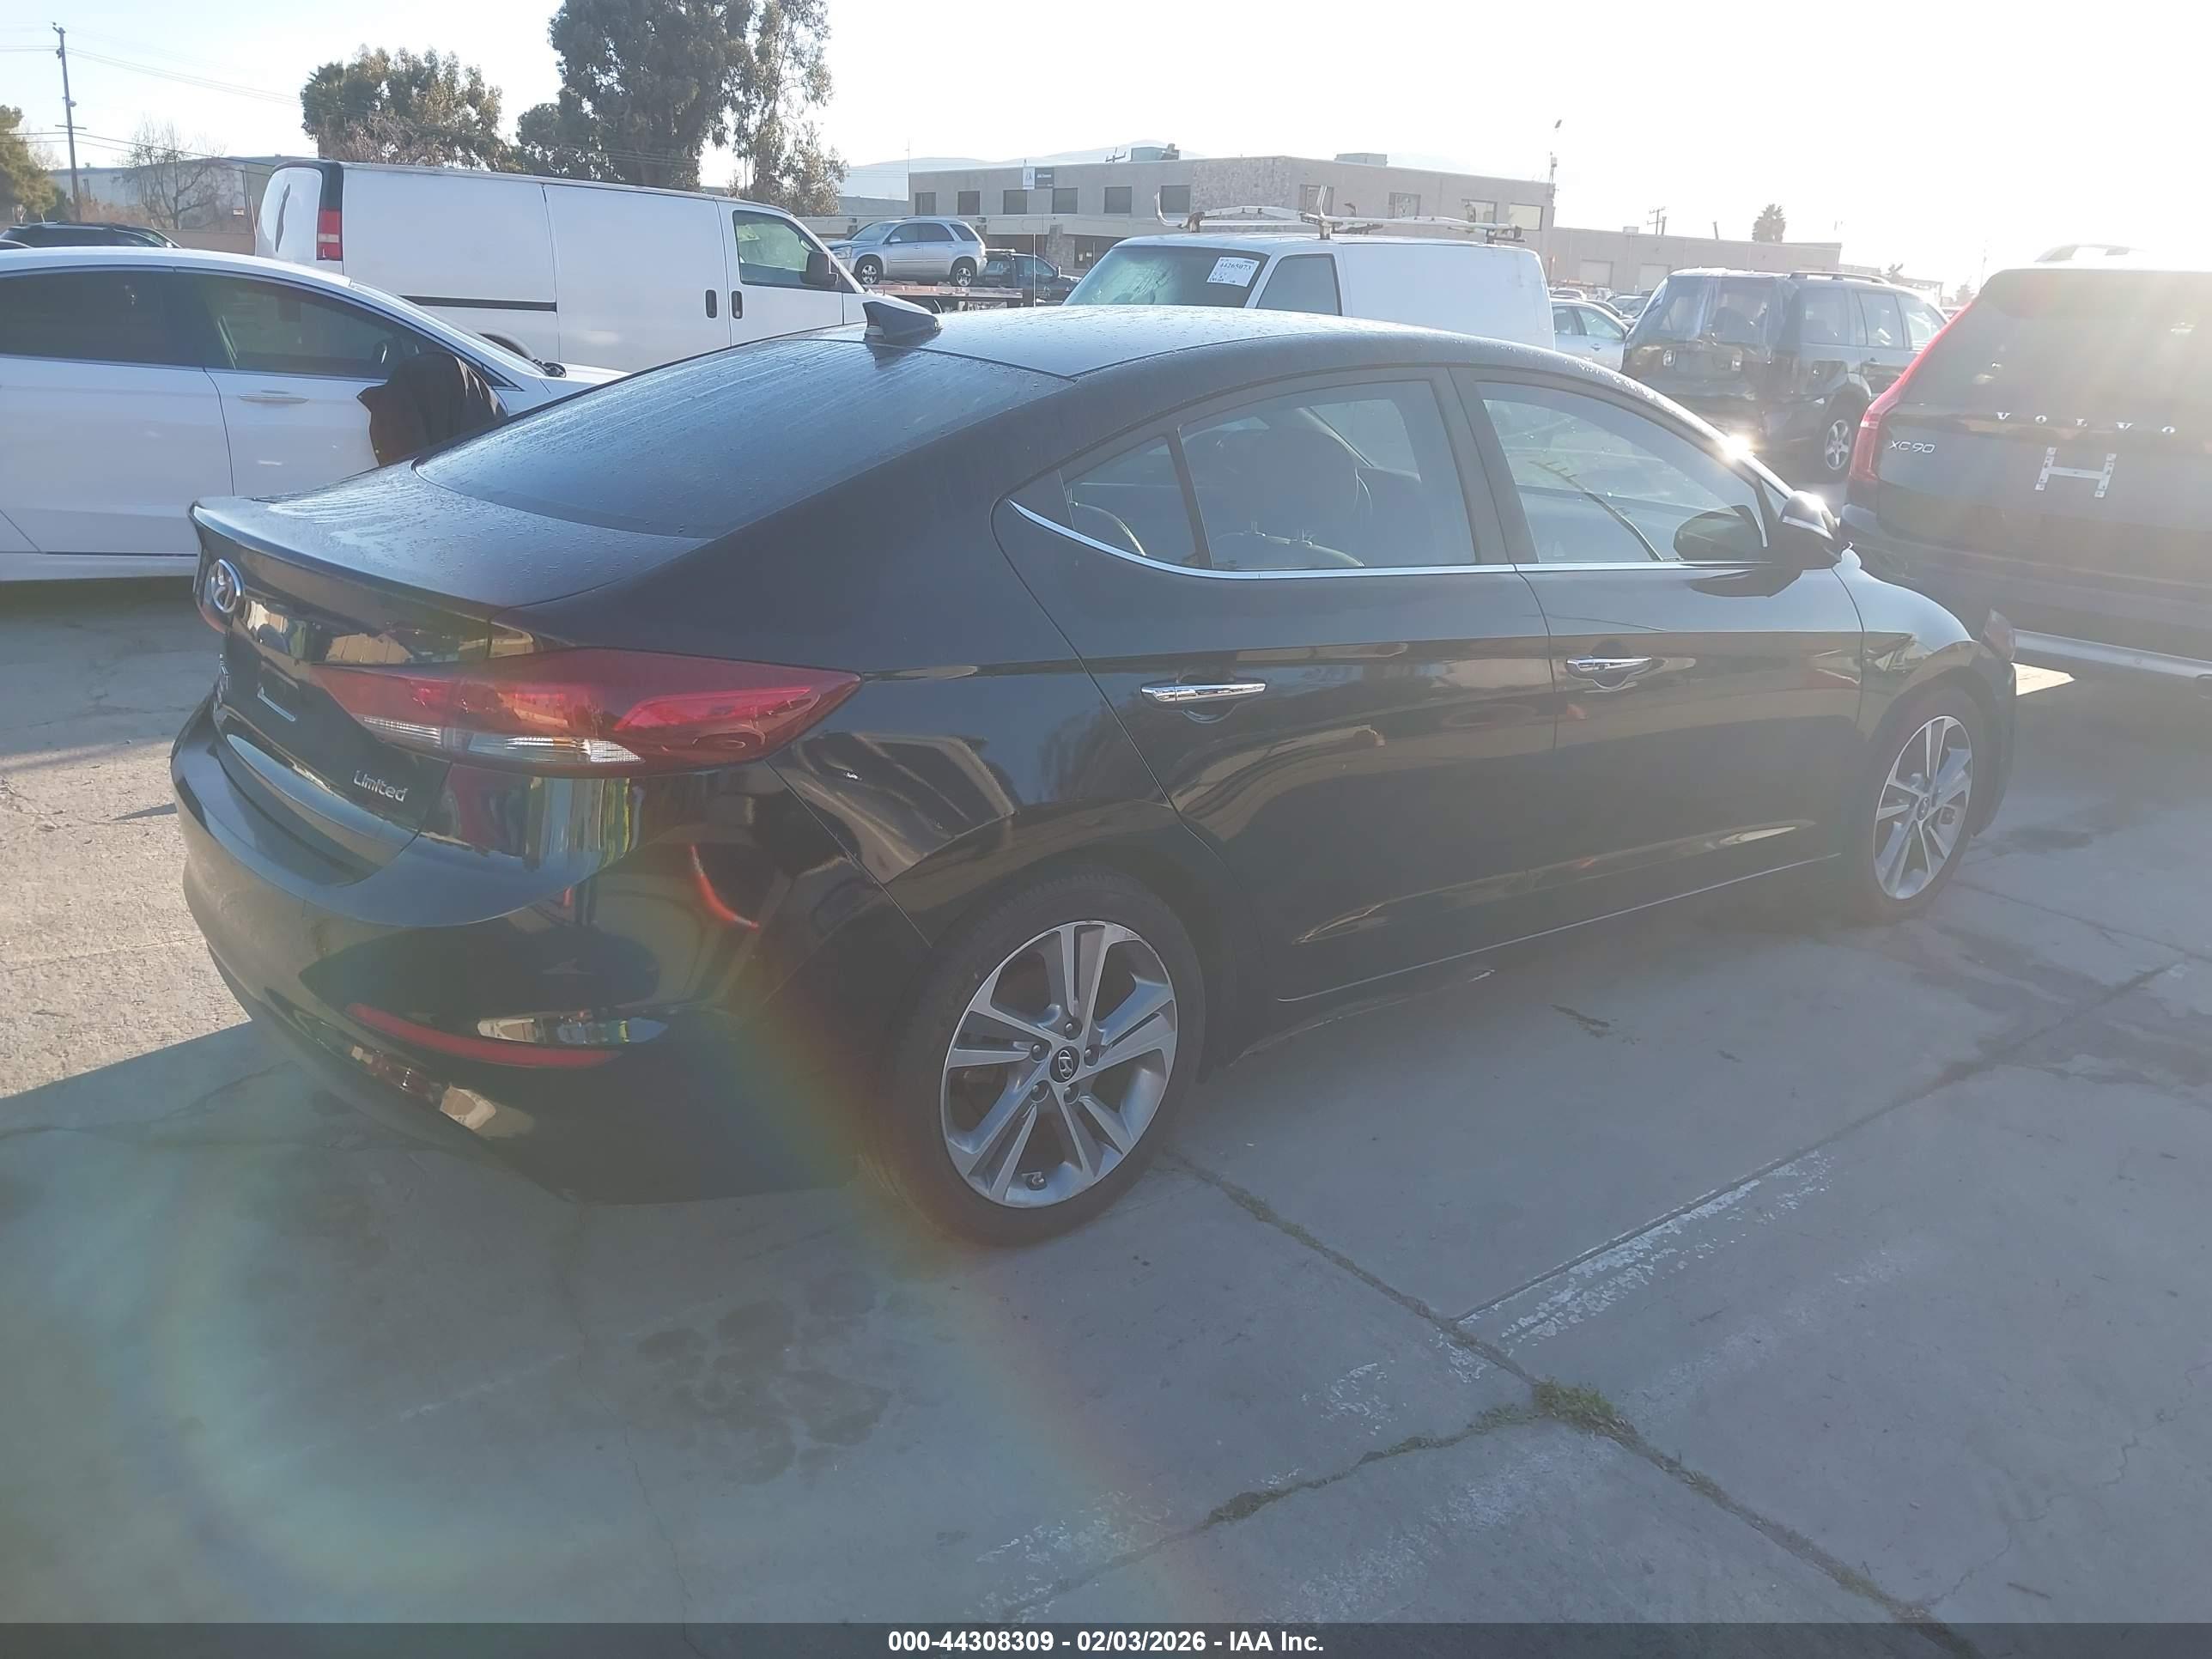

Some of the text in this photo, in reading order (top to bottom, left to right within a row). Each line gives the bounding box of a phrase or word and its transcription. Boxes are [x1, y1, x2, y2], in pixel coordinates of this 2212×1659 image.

[1996, 411, 2176, 434] VOLVO
[1888, 440, 1936, 453] XC90
[353, 769, 409, 803] Limited
